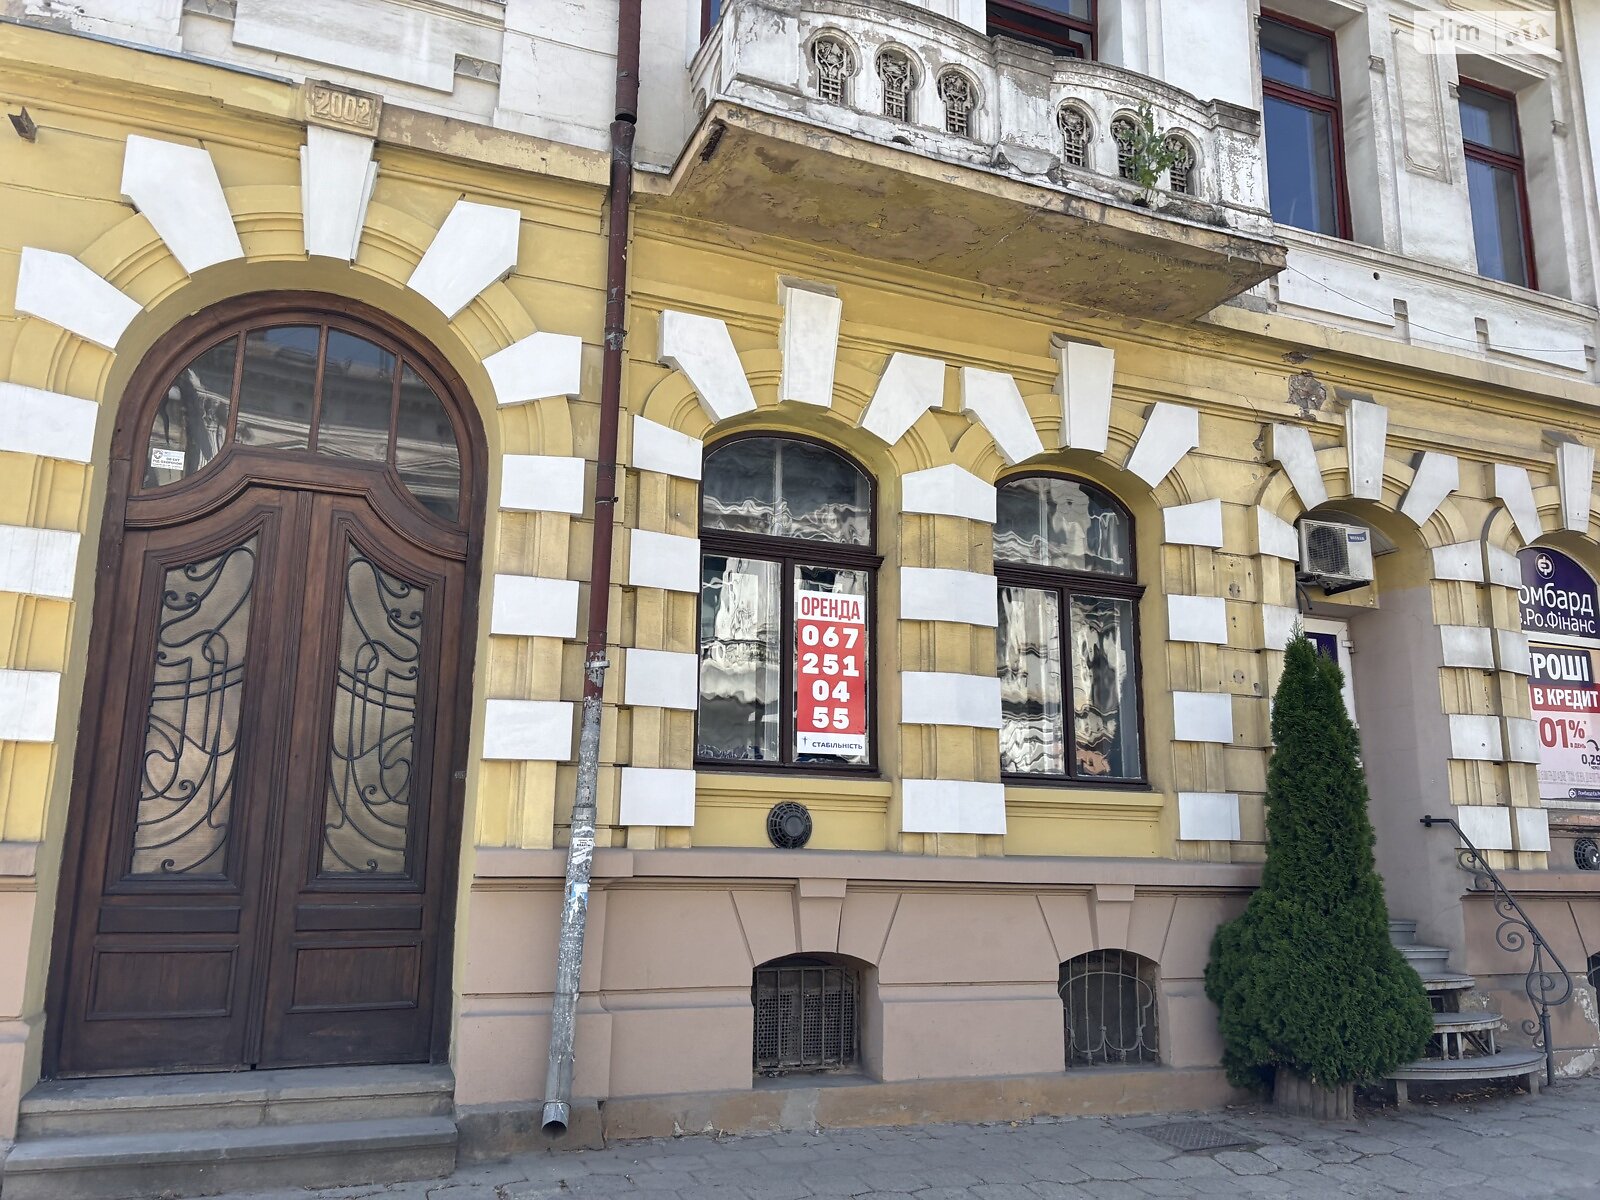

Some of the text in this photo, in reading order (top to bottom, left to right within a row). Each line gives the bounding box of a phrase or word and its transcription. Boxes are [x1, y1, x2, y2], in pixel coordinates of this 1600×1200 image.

[315, 91, 370, 127] 2002
[801, 596, 861, 621] ОРЕНДА
[1518, 583, 1595, 617] омбард
[1519, 608, 1597, 634] .Ро.Фінанс
[801, 624, 859, 649] 067
[802, 652, 860, 677] 251
[812, 679, 850, 703] 04
[1533, 688, 1599, 710] В КРЕДИТ
[812, 706, 850, 730] 55
[812, 741, 863, 750] СТАБІЛЬНІСТЬ
